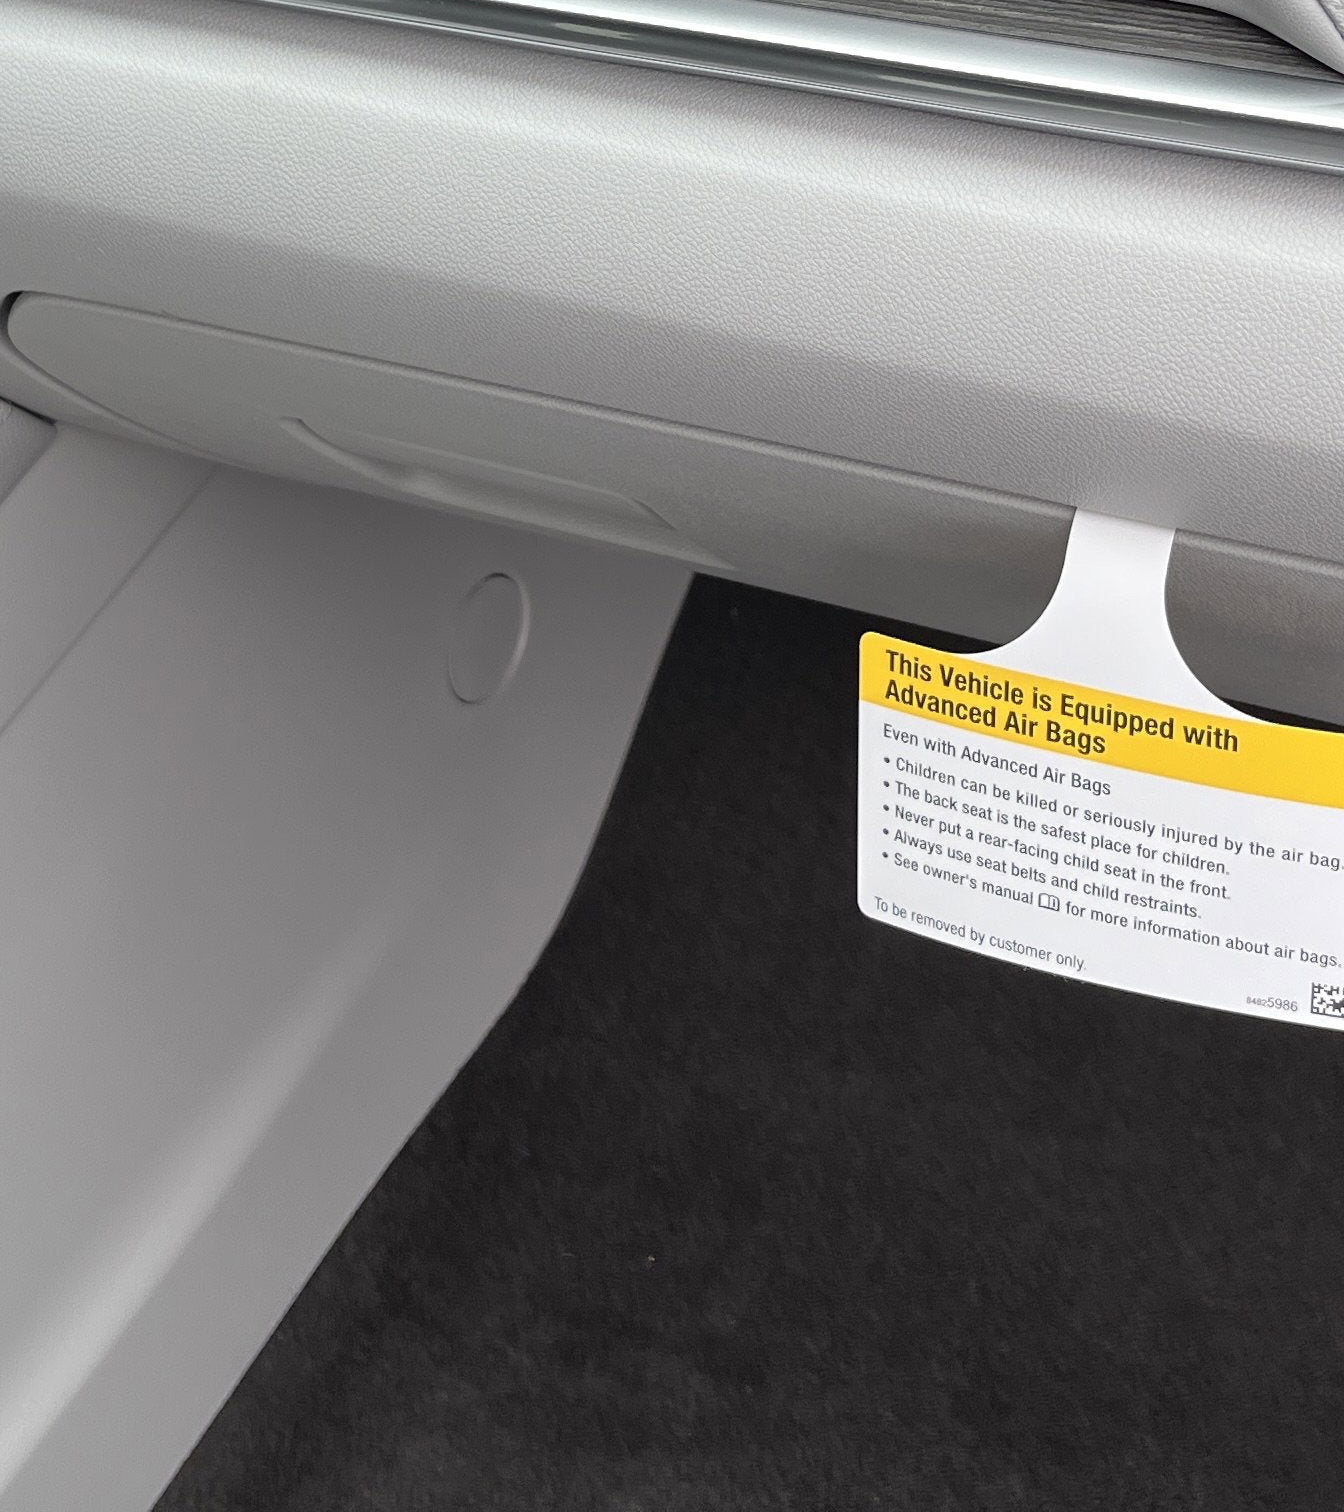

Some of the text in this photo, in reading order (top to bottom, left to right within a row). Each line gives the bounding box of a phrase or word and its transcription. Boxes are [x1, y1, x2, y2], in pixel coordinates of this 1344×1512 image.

[884, 679, 1106, 755] Advanced Air Bags
[885, 649, 1238, 752] This Vehicle is Equipped with
[883, 722, 1111, 796] Even with Advanced Air Bags
[895, 780, 1230, 875] The back seat is the safest place for children.
[895, 804, 1230, 900] Never put a rear-facing child seat in the front.
[896, 757, 1344, 872] Children can be killed or seriously injured by the air bag.
[894, 829, 1202, 919] Always use seat belts and child restraints.
[894, 852, 1342, 968] See owner's manual for more information about air bags.
[874, 896, 1086, 972] To be removed by customer only.
